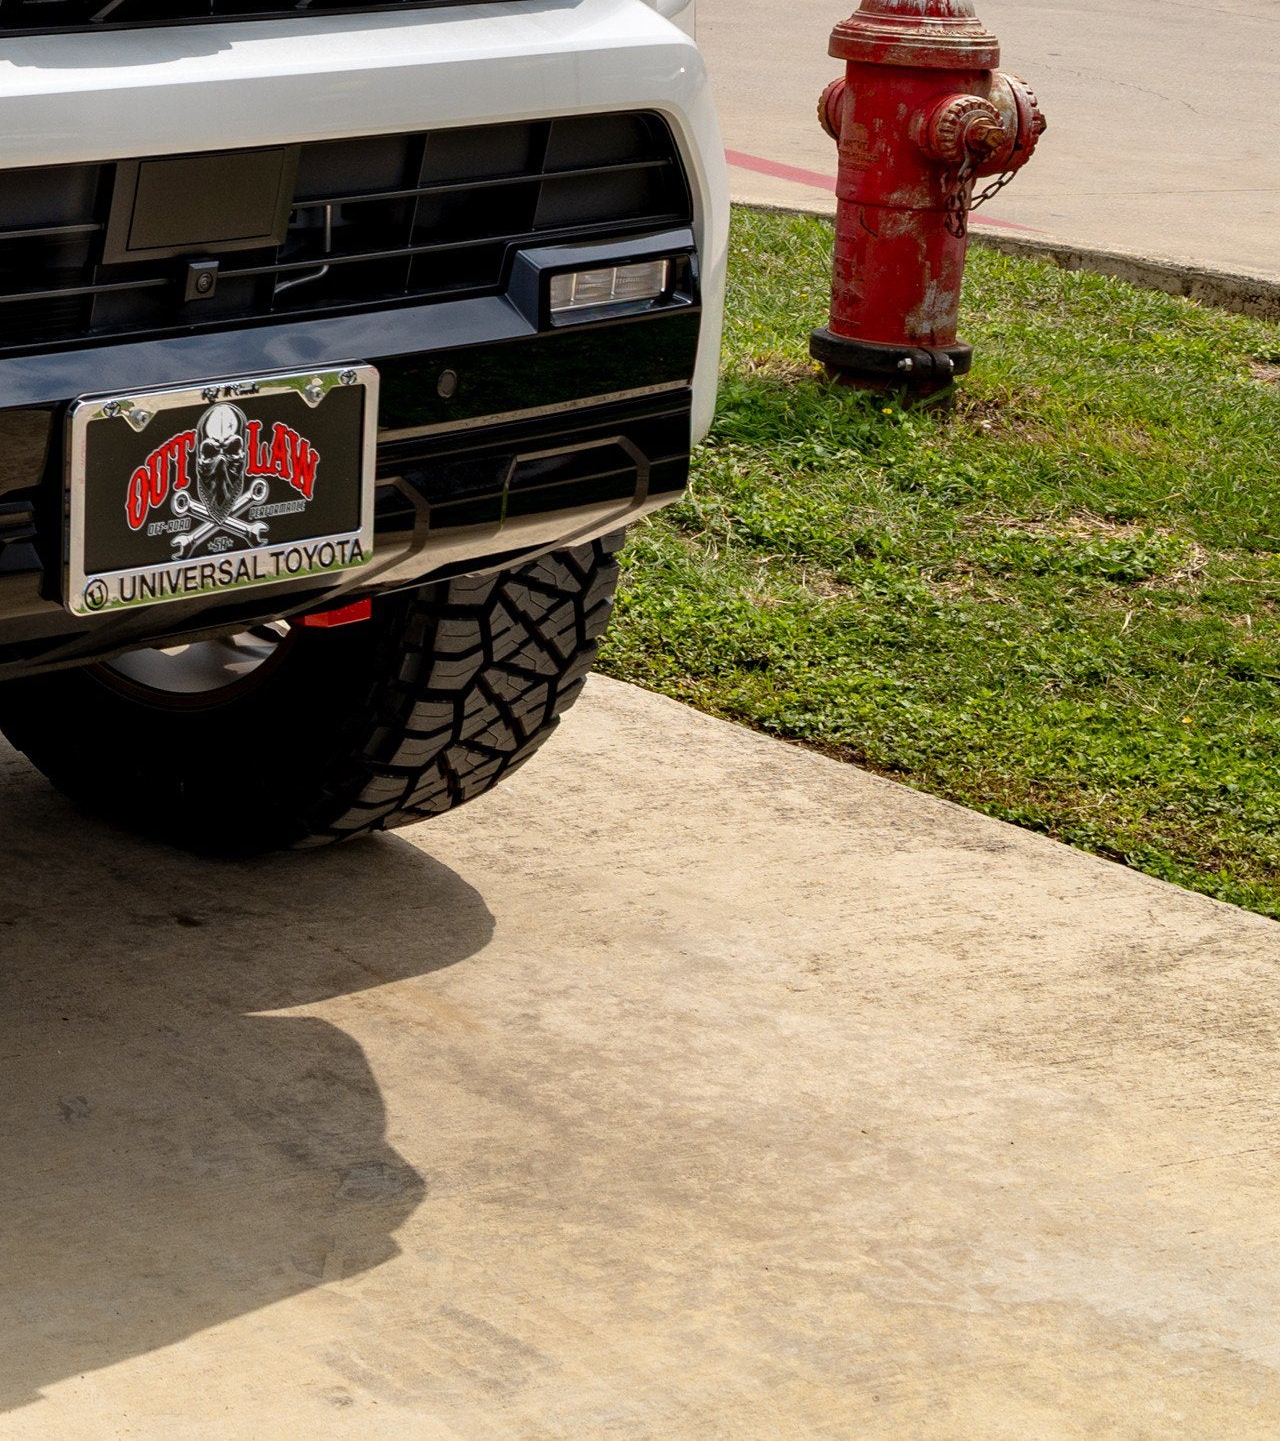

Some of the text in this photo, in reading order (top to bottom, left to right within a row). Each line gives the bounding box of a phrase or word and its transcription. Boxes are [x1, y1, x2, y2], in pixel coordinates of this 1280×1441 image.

[125, 420, 320, 531] OUT LAW
[147, 517, 191, 537] OFF-ROAD
[119, 554, 266, 603] UNIVERSAL
[270, 538, 365, 577] TOYOTA
